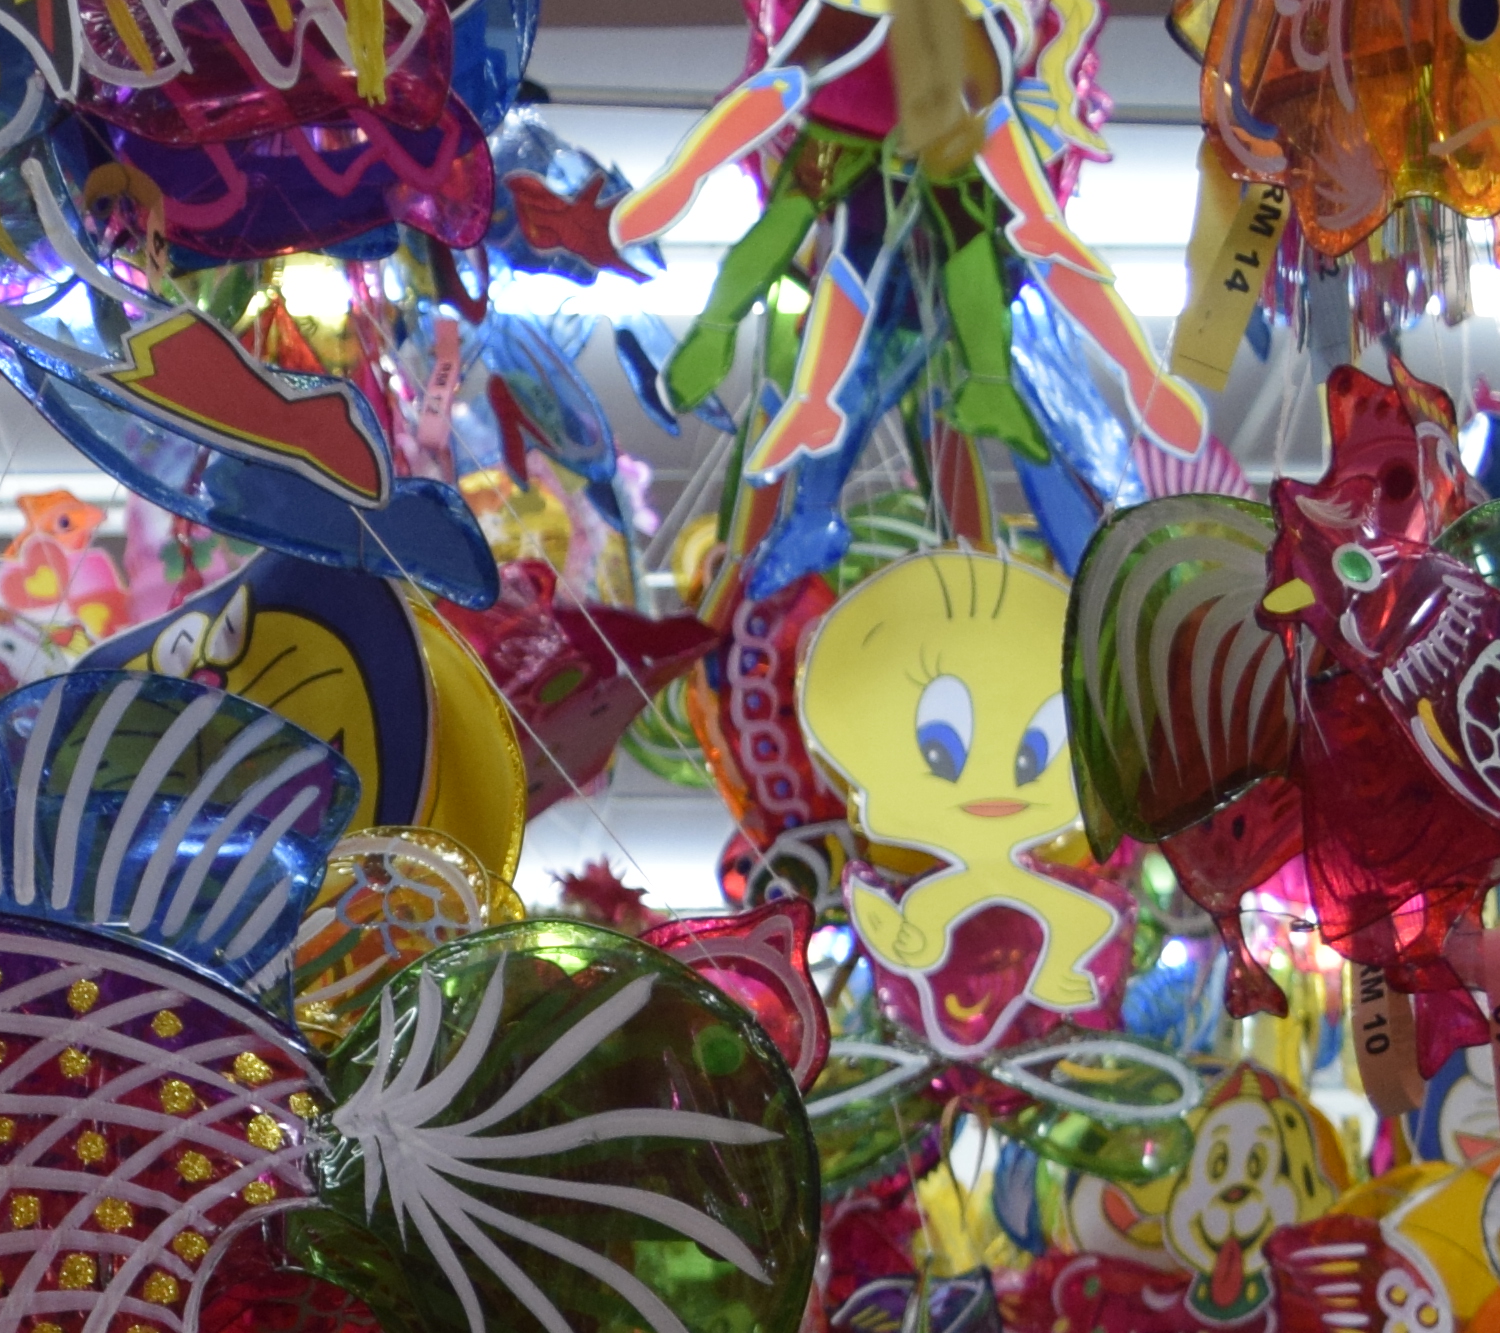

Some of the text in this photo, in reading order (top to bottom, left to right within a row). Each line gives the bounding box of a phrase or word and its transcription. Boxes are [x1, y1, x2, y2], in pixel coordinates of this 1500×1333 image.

[1227, 183, 1287, 295] RM 14
[436, 362, 452, 387] RM
[1358, 962, 1390, 1056] RM 10
